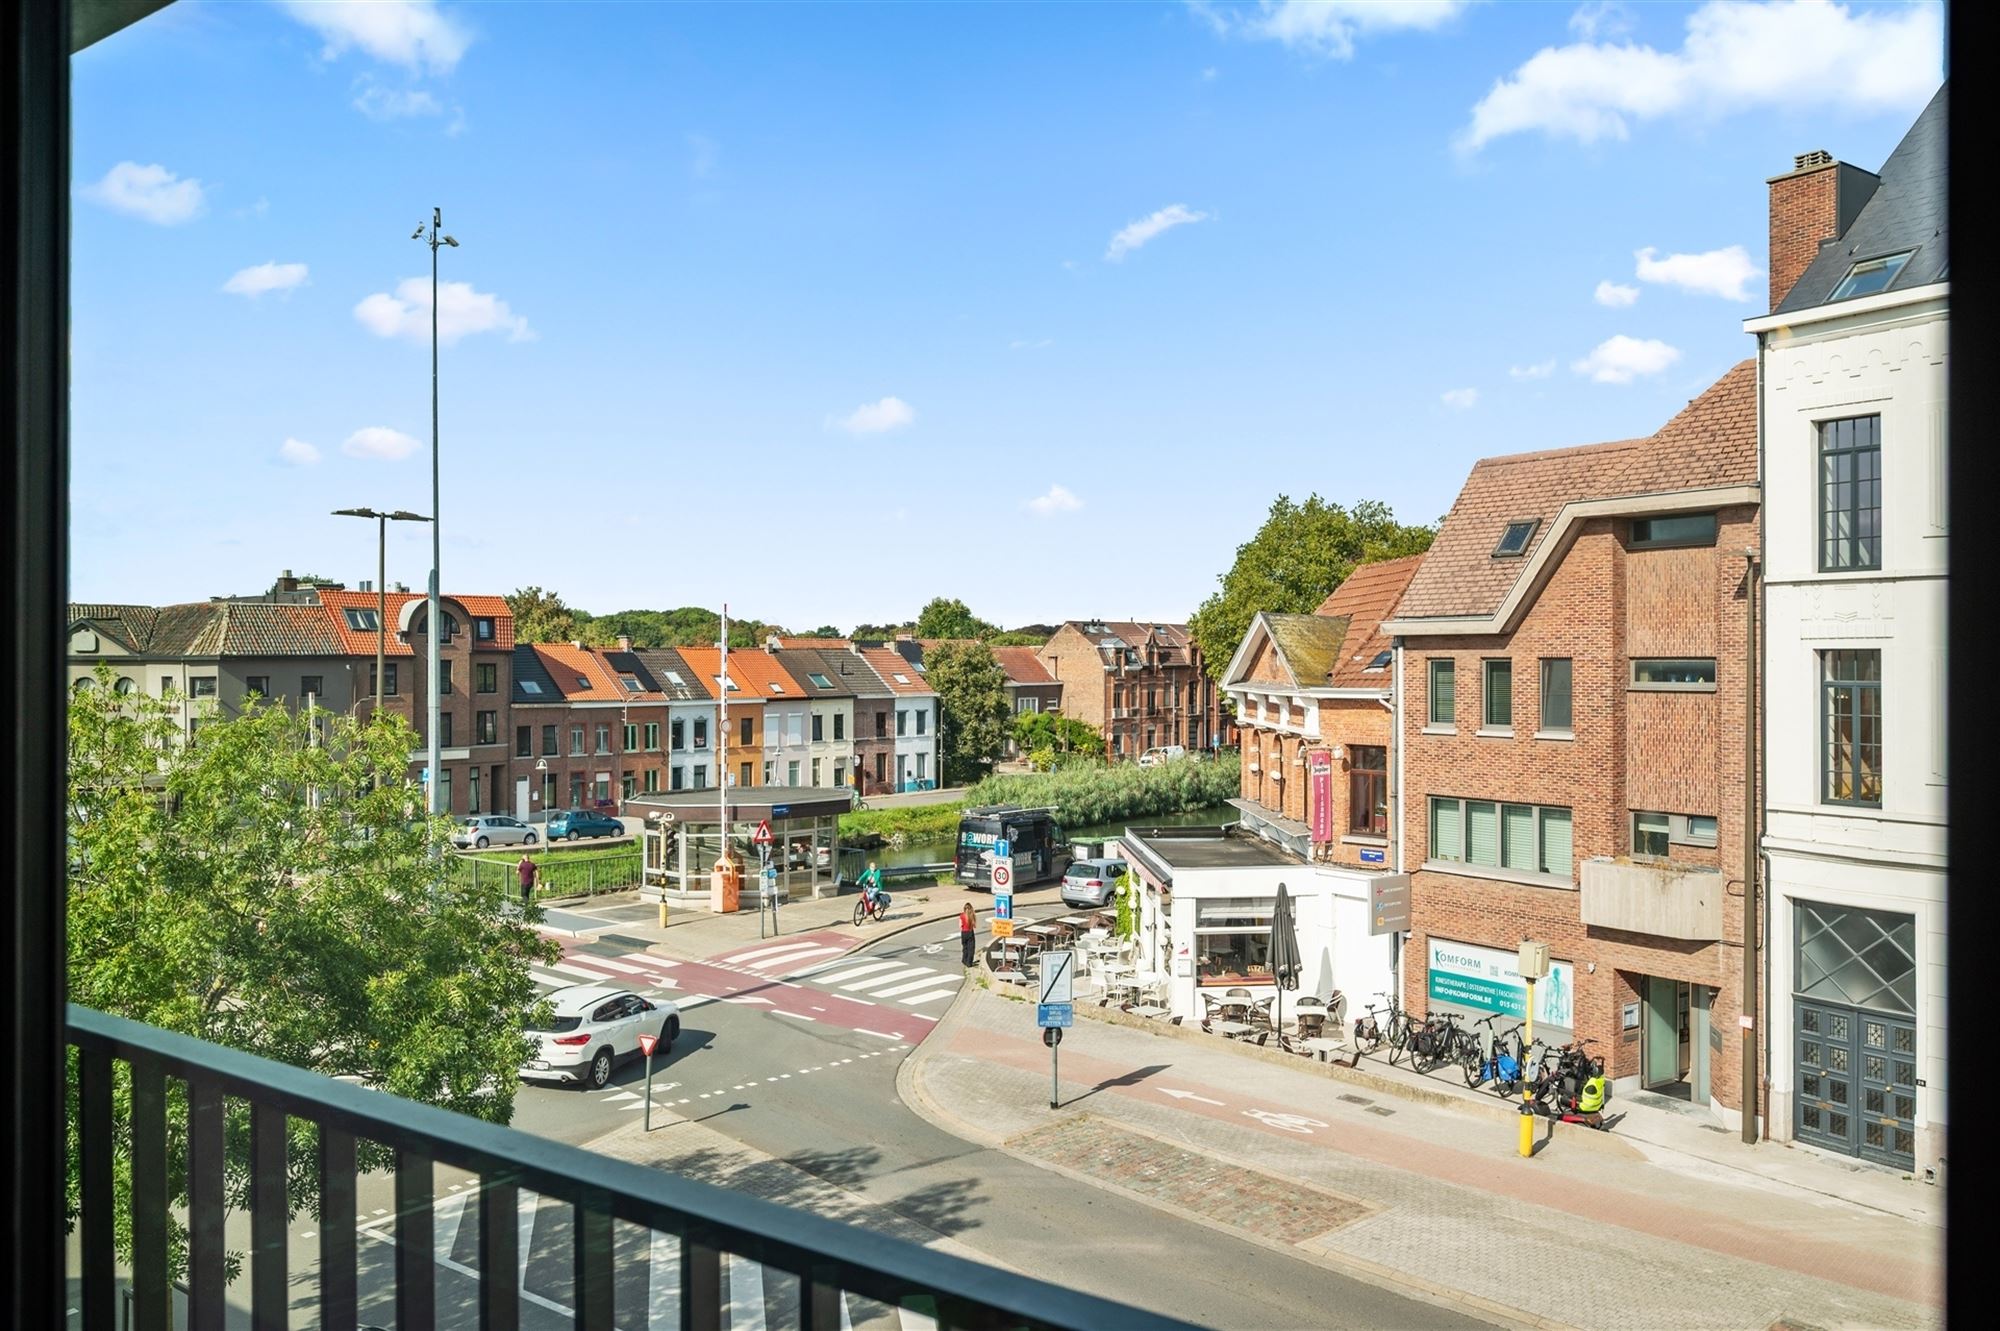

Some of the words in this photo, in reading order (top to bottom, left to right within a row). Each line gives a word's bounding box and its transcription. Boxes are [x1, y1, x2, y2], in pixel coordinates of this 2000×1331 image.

[997, 871, 1006, 880] 30
[1434, 947, 1481, 968] KOMFORM
[1499, 1000, 1510, 1009] 015
